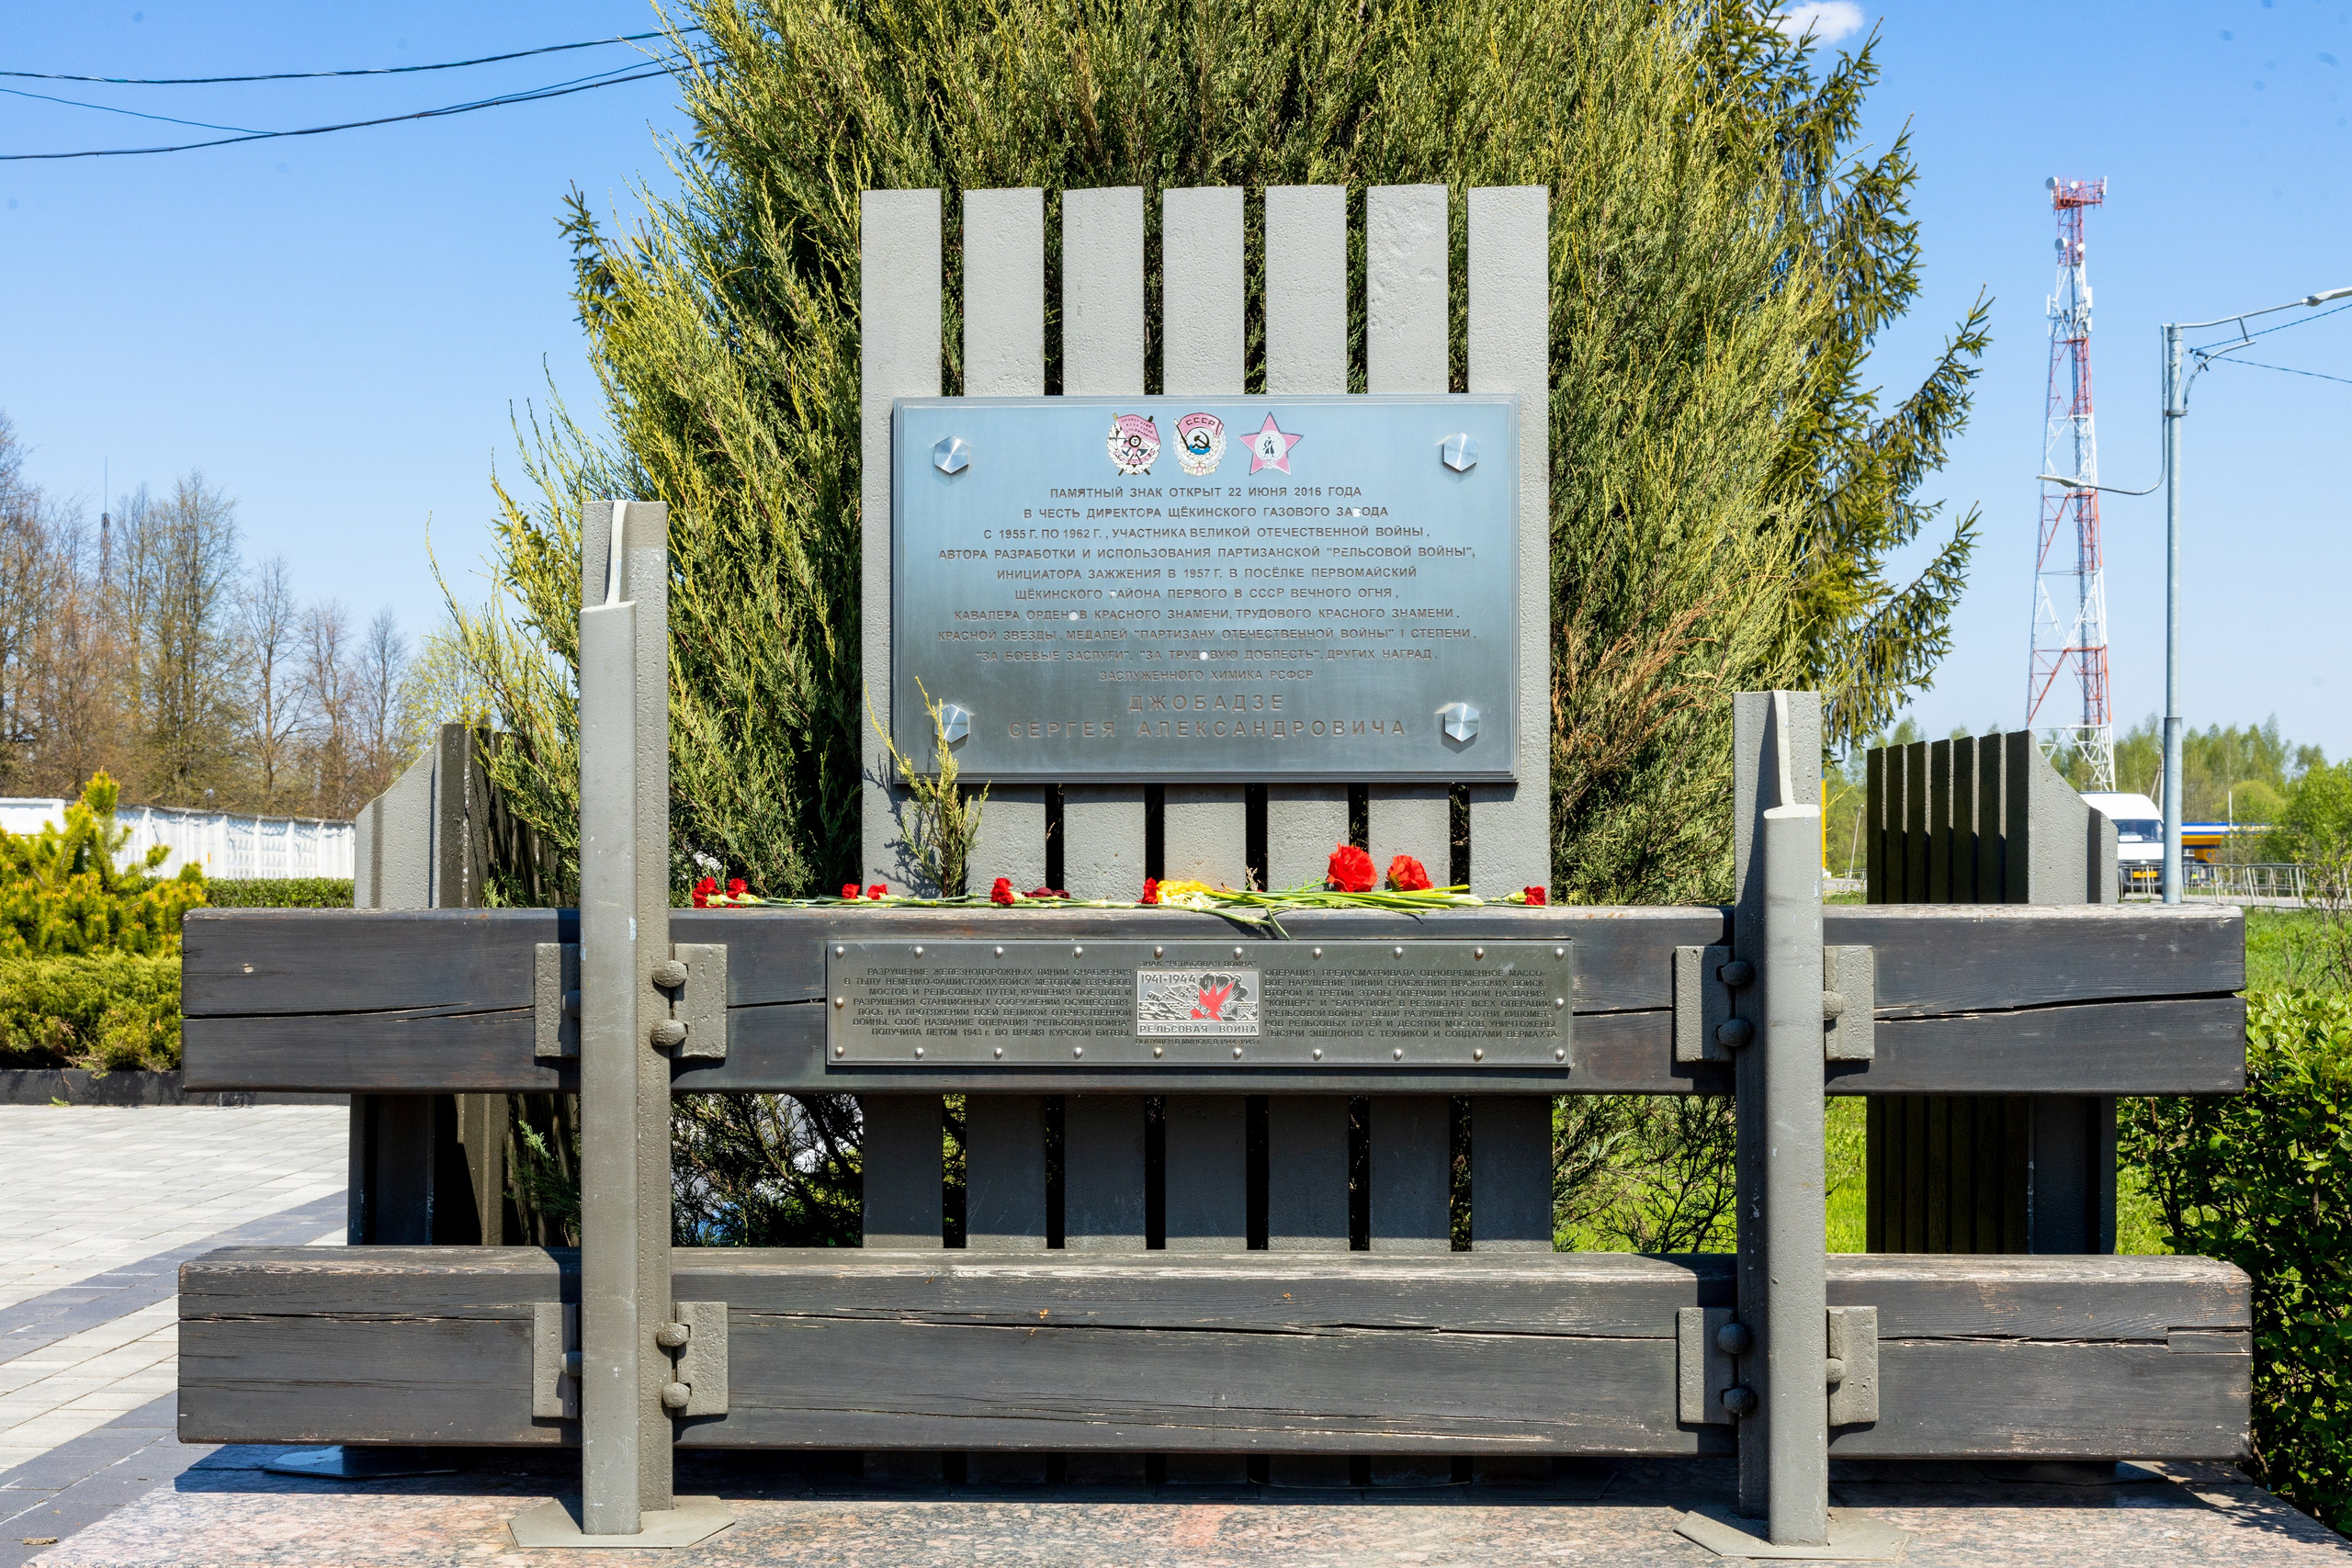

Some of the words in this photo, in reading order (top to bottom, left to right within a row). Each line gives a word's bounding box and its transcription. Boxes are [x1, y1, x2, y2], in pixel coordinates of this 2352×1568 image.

[1185, 416, 1216, 426] СССР
[1050, 485, 1124, 498] ПАМЯТНЫЙ
[1129, 487, 1163, 498] ЗНАК
[1169, 487, 1222, 498] ОТКРЫТ
[1227, 487, 1242, 498] 22
[1248, 487, 1287, 497] ИЮНЯ
[1294, 486, 1322, 497] 2016
[1328, 486, 1363, 499] ГОДА
[1024, 507, 1032, 518] В
[1039, 507, 1080, 518] ЧЕСТЬ
[1086, 507, 1162, 520] ДИРЕКТОРА
[1168, 505, 1257, 520] ЩЁКИНСКОГО
[1263, 506, 1330, 517] ГАЗОВОГО
[983, 528, 992, 539] С
[999, 527, 1026, 539] 1955
[1041, 527, 1059, 539] ПО
[1063, 527, 1091, 539] 1962
[1112, 527, 1187, 538] УЧАСТНИКА
[1191, 525, 1250, 538] ВЕЛИКОЙ
[1257, 525, 1369, 537] ОТЕЧЕСТВЕННОЙ
[938, 548, 989, 559] АВТОРА
[994, 547, 1076, 559] РАЗРАБОТКИ
[1082, 547, 1091, 559] И
[1097, 547, 1211, 558] ИСПОЛЬЗОВАНИЯ
[1217, 545, 1320, 558] ПАРТИЗАНСКОЙ
[997, 569, 1082, 581] ИНИЦИАТОРА
[1088, 569, 1161, 579] ЗАЖЖЕНИЯ
[1168, 568, 1177, 579] В
[1183, 568, 1211, 579] 1957
[1229, 568, 1238, 579] В
[1244, 566, 1305, 579] ПОСЁЛКЕ
[1311, 566, 1417, 579] ПЕРВОМАЙСКИЙ
[1014, 587, 1102, 602] ЩЁКИНСКОГО
[1168, 588, 1227, 599] ПЕРВОГО
[1234, 588, 1243, 599] В
[1250, 588, 1285, 599] СССР
[1291, 588, 1351, 599] ВЕЧНОГО
[955, 610, 1020, 620] КАВАЛЕРА
[1094, 609, 1161, 620] КРАСНОГО
[1236, 609, 1312, 621] ТРУДОВОГО
[1318, 608, 1385, 619] КРАСНОГО
[938, 627, 997, 641] КРАСНОЙ
[1066, 627, 1128, 642] МЕДАЛЕЙ
[1221, 626, 1334, 639] ОТЕЧЕСТВЕННОЙ
[1005, 649, 1060, 661] БОЕВЫЕ
[1326, 649, 1375, 662] ДРУГИХ
[1099, 670, 1204, 682] ЗАСЛУЖЕННОГО
[1210, 670, 1263, 681] ХИМИКА
[1270, 670, 1314, 681] РСФСР
[1128, 694, 1283, 714] ДЖОБАДЗЕ
[1009, 721, 1116, 738] СЕРГЕЯ
[1137, 720, 1406, 739] АЛЕКСАНДРОВИЧА
[867, 967, 929, 976] РАЗРУШЕНИЕ
[933, 968, 1034, 977] ЖЕЛЕЗНОДОРОЖНЫХ
[1073, 968, 1132, 976] СНАБЖЕНИЯ
[1264, 968, 1316, 977] ОПЕРАЦИЯ
[1322, 969, 1416, 977] ПРЕДУСМАТРИВАЛА
[1419, 969, 1505, 978] ОДНОВРЕМЕННОЕ
[854, 977, 881, 986] ТЫЛУ
[886, 977, 997, 987] НЕМЕЦКО-ФАШИСТСКИХ
[1035, 978, 1081, 987] МЕТОДОМ
[1085, 978, 1132, 987] ВЗРЫВОВ
[1264, 978, 1284, 987] ВОЕ
[1288, 978, 1346, 987] НАРУШЕНИЕ
[1387, 979, 1447, 987] СНАБЖЕНИЯ
[1451, 979, 1509, 987] ВРАЖЕСКИХ
[869, 987, 909, 996] МОСТОВ
[923, 987, 982, 996] РЕЛЬСОВЫХ
[1020, 988, 1071, 997] КРУШЕНИЯ
[1076, 988, 1121, 998] ПОЕЗДОВ
[1358, 989, 1392, 998] ЭТАПЫ
[1396, 989, 1447, 998] ОПЕРАЦИИ
[1495, 989, 1545, 998] НАЗВАНИЯ
[853, 998, 916, 1006] РАЗРУШЕНИЯ
[920, 998, 990, 1007] СТАНЦИОННЫХ
[1410, 999, 1467, 1008] РЕЗУЛЬТАТЕ
[1471, 999, 1497, 1008] ВСЕХ
[857, 1008, 884, 1016] ЛОСЬ
[888, 1008, 901, 1016] НА
[905, 1008, 969, 1016] ПРОТЯЖЕНИИ
[1372, 1010, 1400, 1018] БЫЛИ
[1404, 1010, 1464, 1018] РАЗРУШЕНЫ
[1467, 1010, 1500, 1018] СОТНИ
[894, 1017, 920, 1026] СВОЁ
[924, 1018, 974, 1026] НАЗВАНИЕ
[978, 1018, 1028, 1027] ОПЕРАЦИЯ
[1264, 1019, 1284, 1027] РОВ
[1288, 1019, 1347, 1027] РЕЛЬСОВЫХ
[1397, 1020, 1442, 1028] ДЕСЯТКИ
[1489, 1020, 1555, 1028] УНИЧТОЖЕНЫ
[871, 1028, 922, 1036] ПОЛУЧИЛА
[925, 1028, 958, 1036] ЛЕТОМ
[962, 1028, 982, 1036] 1943
[994, 1028, 1009, 1036] ВО
[1012, 1029, 1045, 1037] ВРЕМЯ
[1264, 1029, 1306, 1037] ТЫСЯЧИ
[1309, 1029, 1363, 1037] ЭШЕЛОНОВ
[1444, 1030, 1502, 1039] СОЛДАТАМИ
